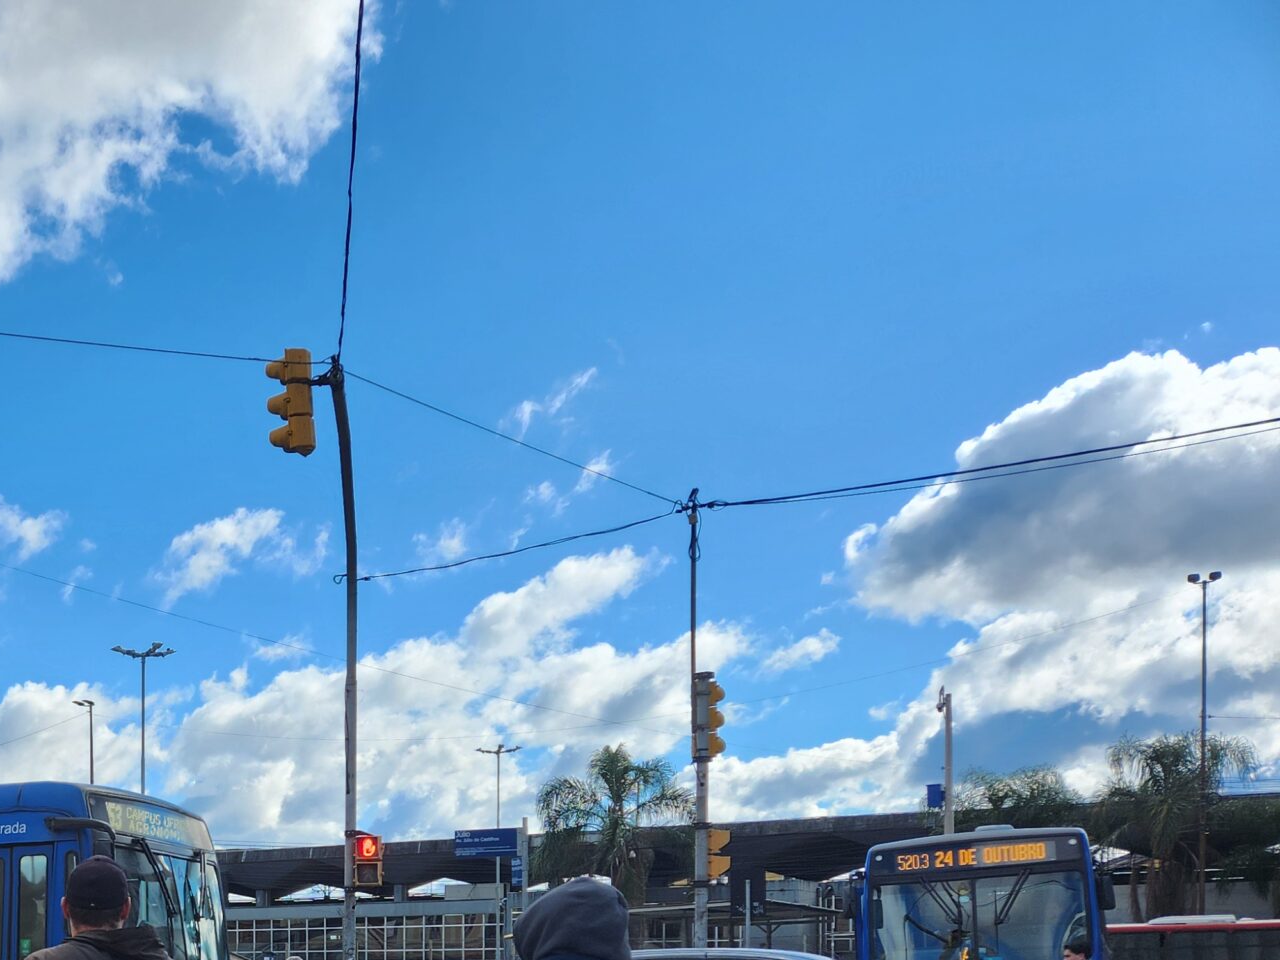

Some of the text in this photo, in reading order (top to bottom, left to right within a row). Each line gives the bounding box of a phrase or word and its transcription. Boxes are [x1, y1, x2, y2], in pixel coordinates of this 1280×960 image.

[126, 808, 160, 825] CAMPUS
[897, 842, 1046, 871] 520.3 24 DE OUTUBRO
